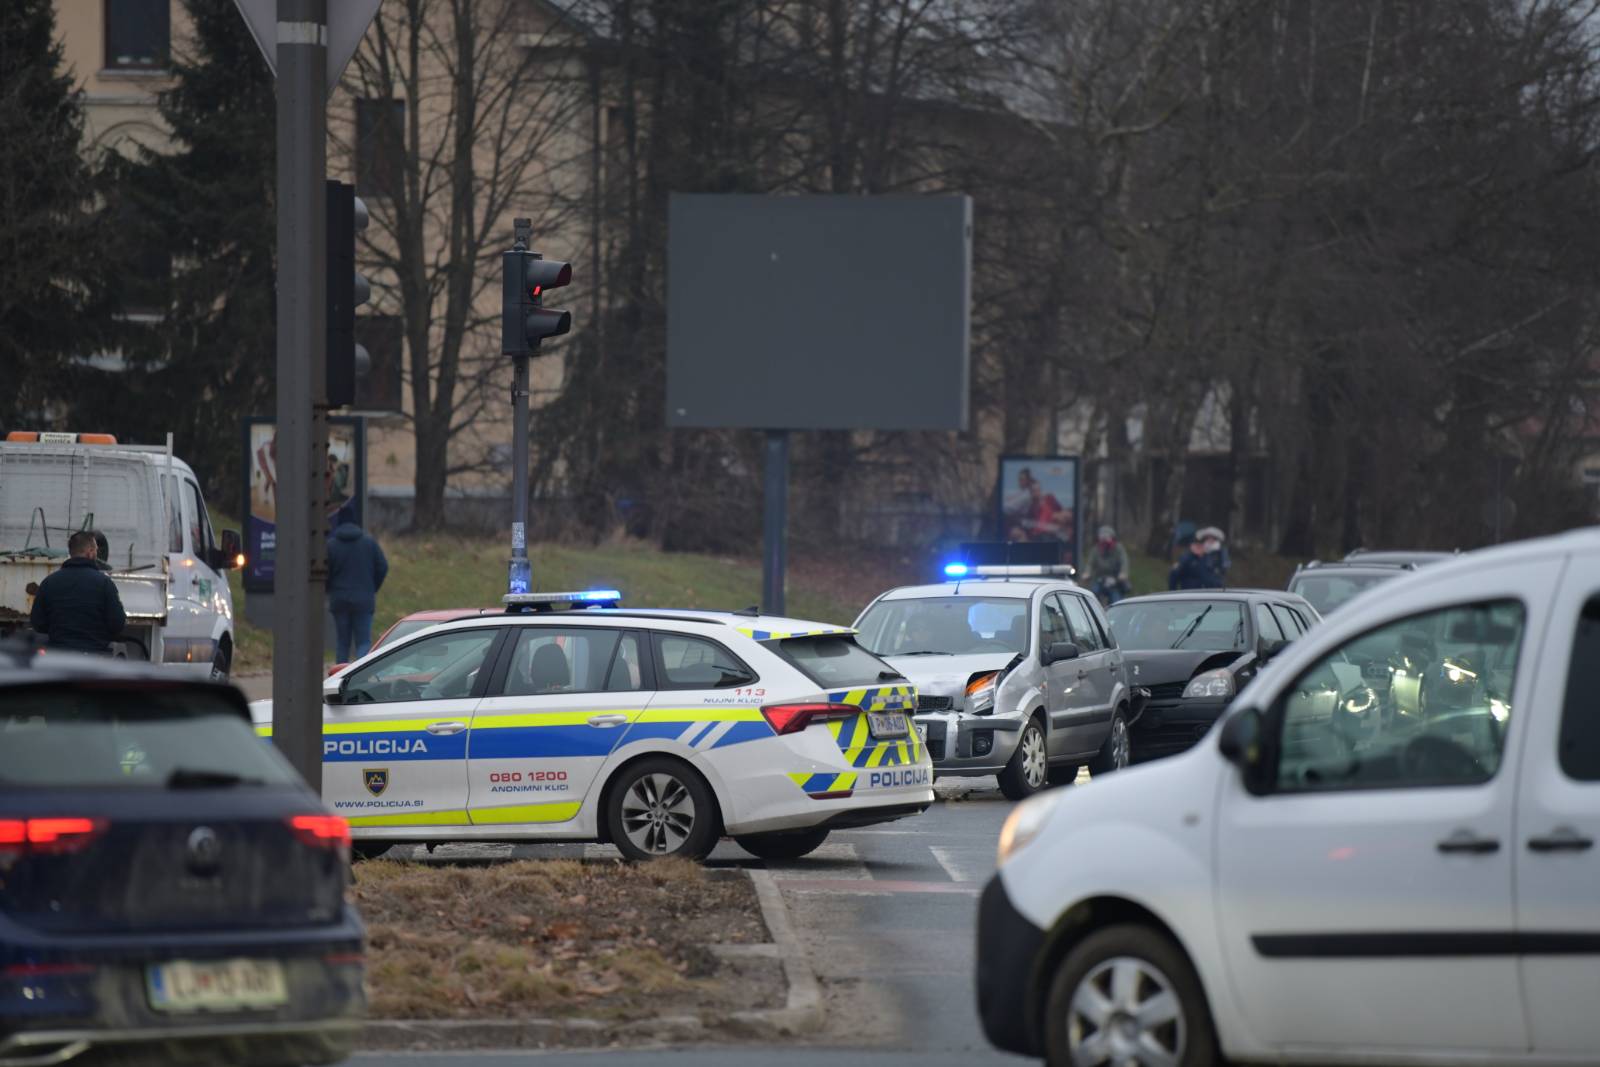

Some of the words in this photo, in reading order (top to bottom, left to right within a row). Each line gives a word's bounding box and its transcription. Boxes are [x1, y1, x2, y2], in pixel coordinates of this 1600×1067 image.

[735, 688, 765, 696] 113
[323, 739, 427, 754] POLICIJA
[490, 773, 522, 783] 080
[527, 771, 568, 782] 1200
[870, 769, 928, 787] POLICIJA
[491, 784, 543, 792] ANONIMNI
[544, 784, 569, 792] KLICI
[334, 800, 424, 808] WWW.POLICIJA.SI
